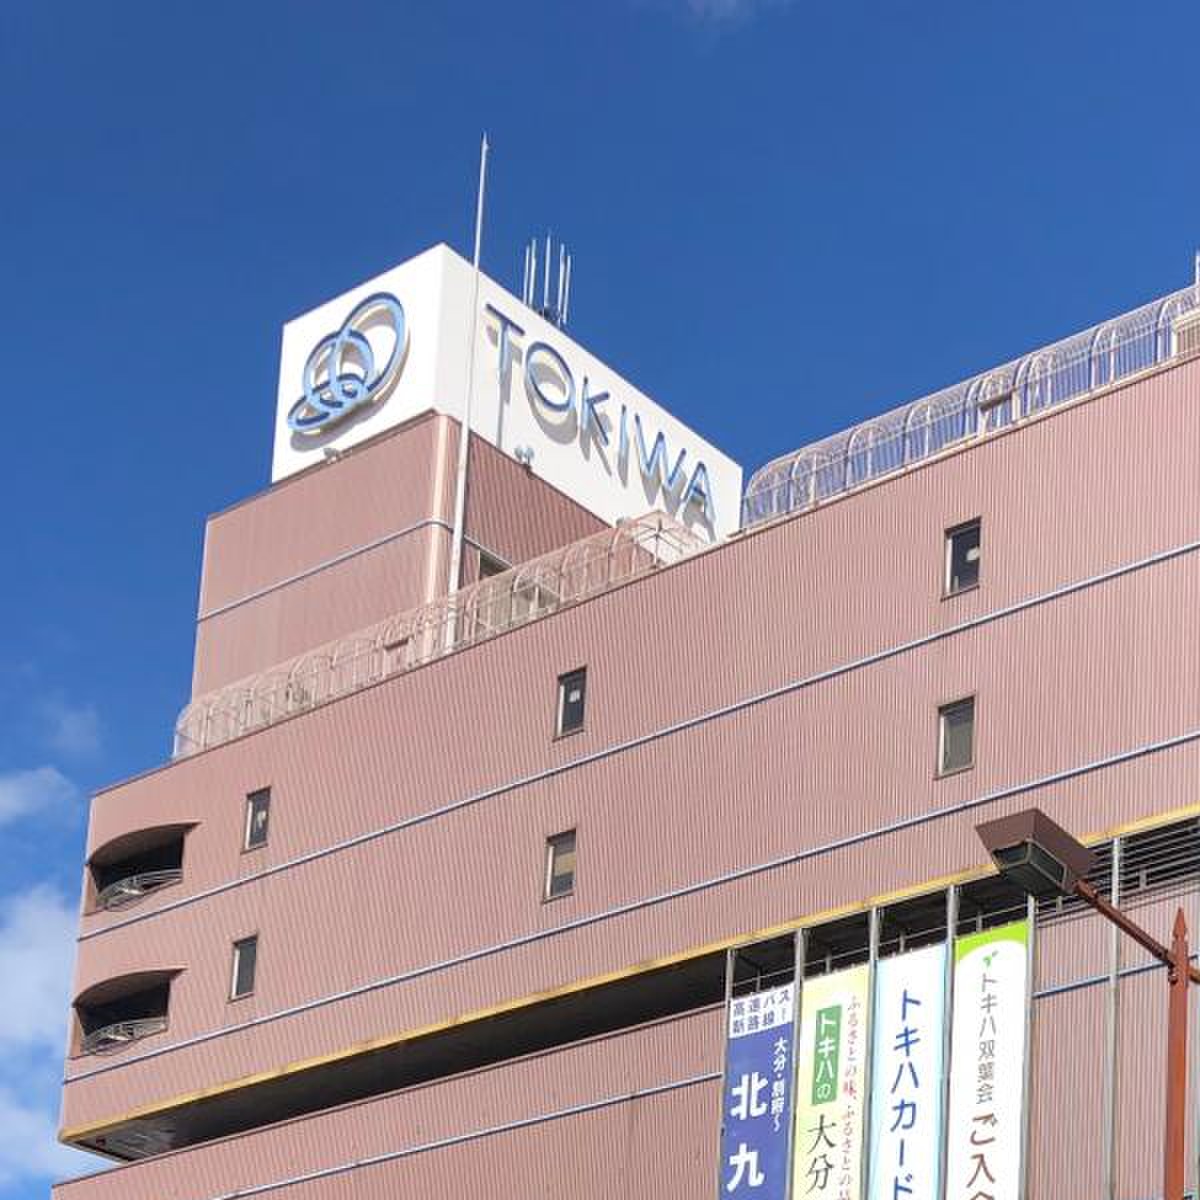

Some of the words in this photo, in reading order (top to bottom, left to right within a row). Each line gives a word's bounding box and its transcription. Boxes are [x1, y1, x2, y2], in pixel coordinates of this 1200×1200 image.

[486, 303, 716, 522] TOKIWA
[815, 1012, 838, 1099] トキハの
